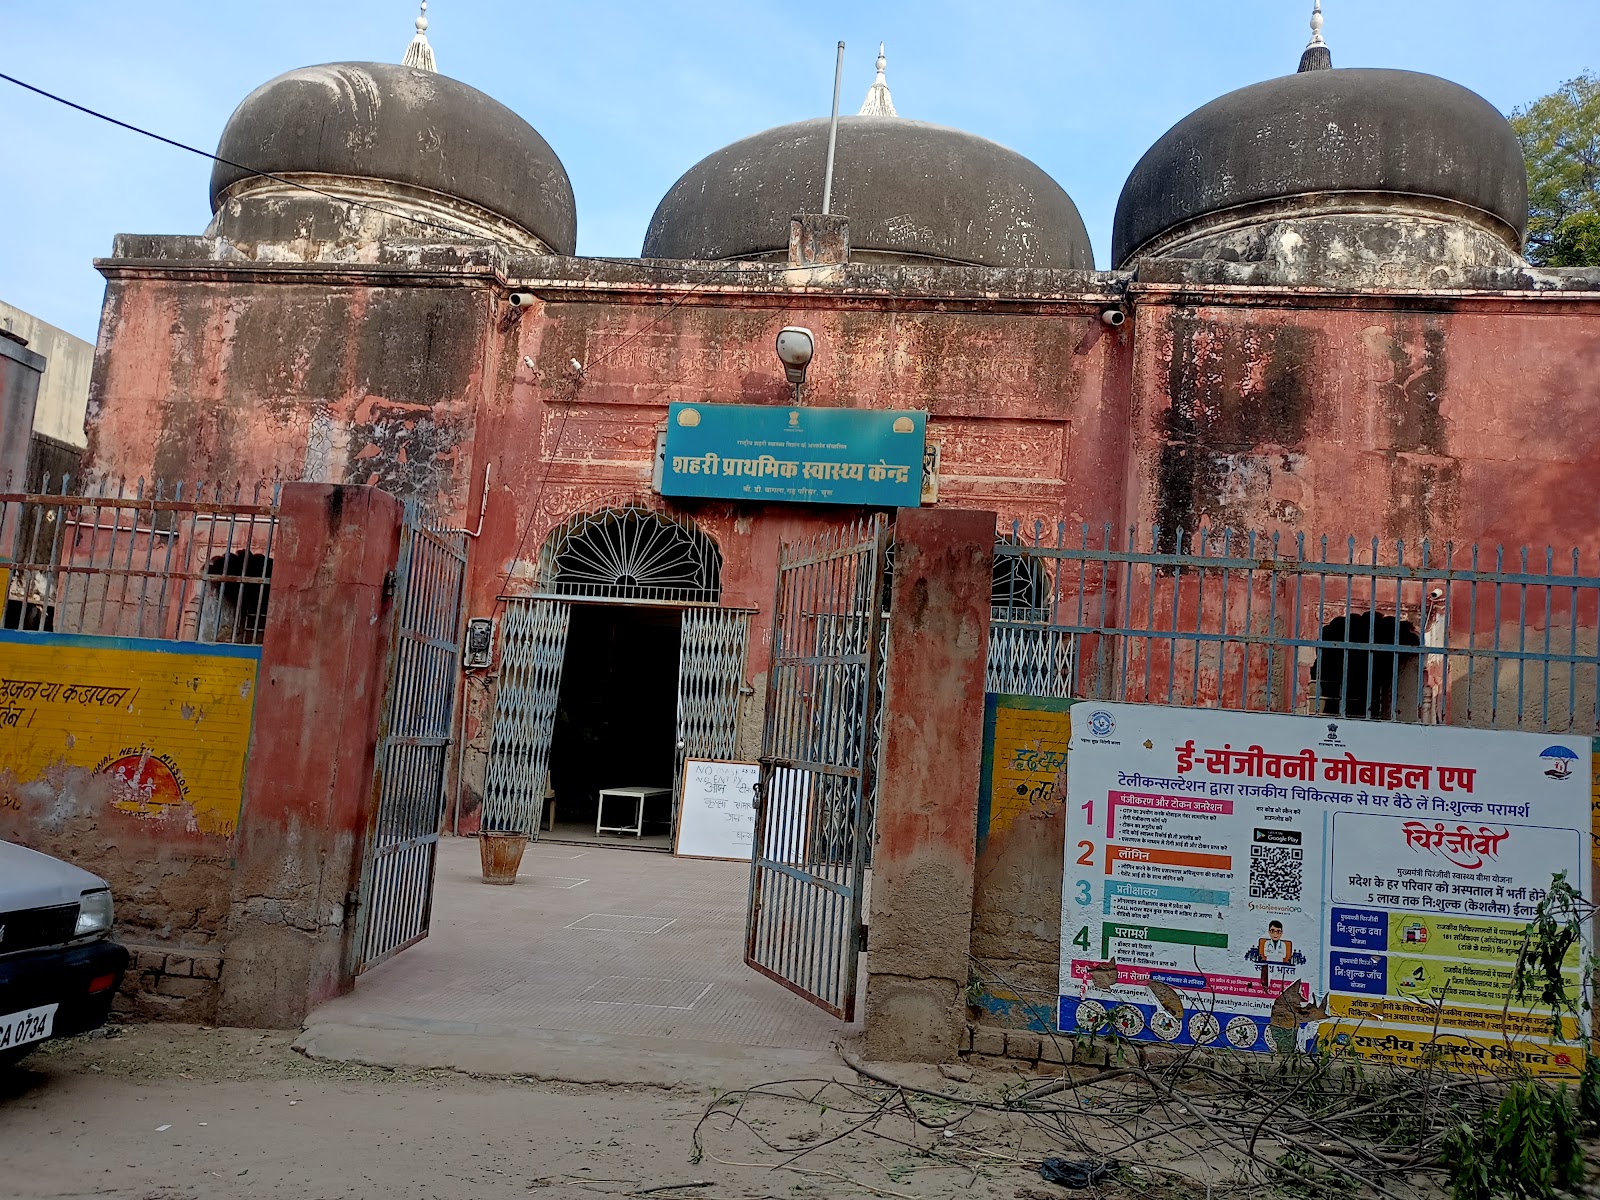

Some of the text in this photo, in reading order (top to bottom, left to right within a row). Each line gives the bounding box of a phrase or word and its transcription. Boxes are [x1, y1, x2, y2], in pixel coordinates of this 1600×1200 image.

[672, 452, 910, 484] शहरी प्राथमिक स्वास्थ्य केन्द्र
[41, 682, 64, 702] या
[62, 684, 131, 708] कड़ापन
[695, 766, 712, 775] NO
[1174, 740, 1477, 793] ई-संजीवनी मोबाइल एप
[1118, 771, 1206, 793] टेलीकन्सल्टेशन
[1209, 781, 1235, 796] द्वारा
[1237, 780, 1288, 800] राजकीय
[1291, 785, 1353, 806] चिकित्सक
[1356, 790, 1369, 806] से
[1372, 793, 1389, 808] घर
[1392, 792, 1412, 810] बैठे
[1416, 794, 1429, 811] लें
[1486, 802, 1530, 818] परामर्श
[1120, 795, 1223, 812] पंजीकरण और टोकन जनरेशन
[1081, 800, 1094, 826] 1
[1076, 839, 1095, 867] 2
[1118, 848, 1151, 860] लॉगिन
[1402, 821, 1510, 870] चिरंजीवी
[1396, 867, 1512, 884] मुख्यमंत्री चिरंजीवी स्वास्थ्य बीमा योजना
[1075, 880, 1092, 906] 3
[1116, 884, 1159, 896] प्रतीक्षालय
[1348, 875, 1372, 888] प्रदेश
[1374, 874, 1385, 888] के
[1386, 879, 1400, 890] हर
[1402, 878, 1432, 892] परिवार
[1435, 880, 1450, 893] को
[1452, 884, 1494, 896] अस्पताल
[1496, 883, 1505, 897] में
[1506, 886, 1526, 900] भर्ती
[1528, 890, 1546, 902] होने
[1368, 892, 1374, 902] 5
[1377, 894, 1400, 905] लाख
[1402, 895, 1420, 906] तक
[1464, 898, 1510, 916] (केशलैस)
[1072, 926, 1091, 951] 4
[1114, 927, 1149, 940] परामर्श
[1368, 928, 1382, 936] दवा
[1130, 970, 1150, 980] सेवाएं
[1276, 965, 1296, 975] भारत
[1366, 970, 1382, 980] जाँच
[1351, 1000, 1369, 1008] अधिक
[1395, 1002, 1402, 1010] के
[1402, 1003, 1414, 1012] लिए
[1464, 1011, 1483, 1019] स्वास्थ्य
[15, 1013, 48, 1043] 0734
[1354, 1034, 1414, 1052] राष्ट्रीय
